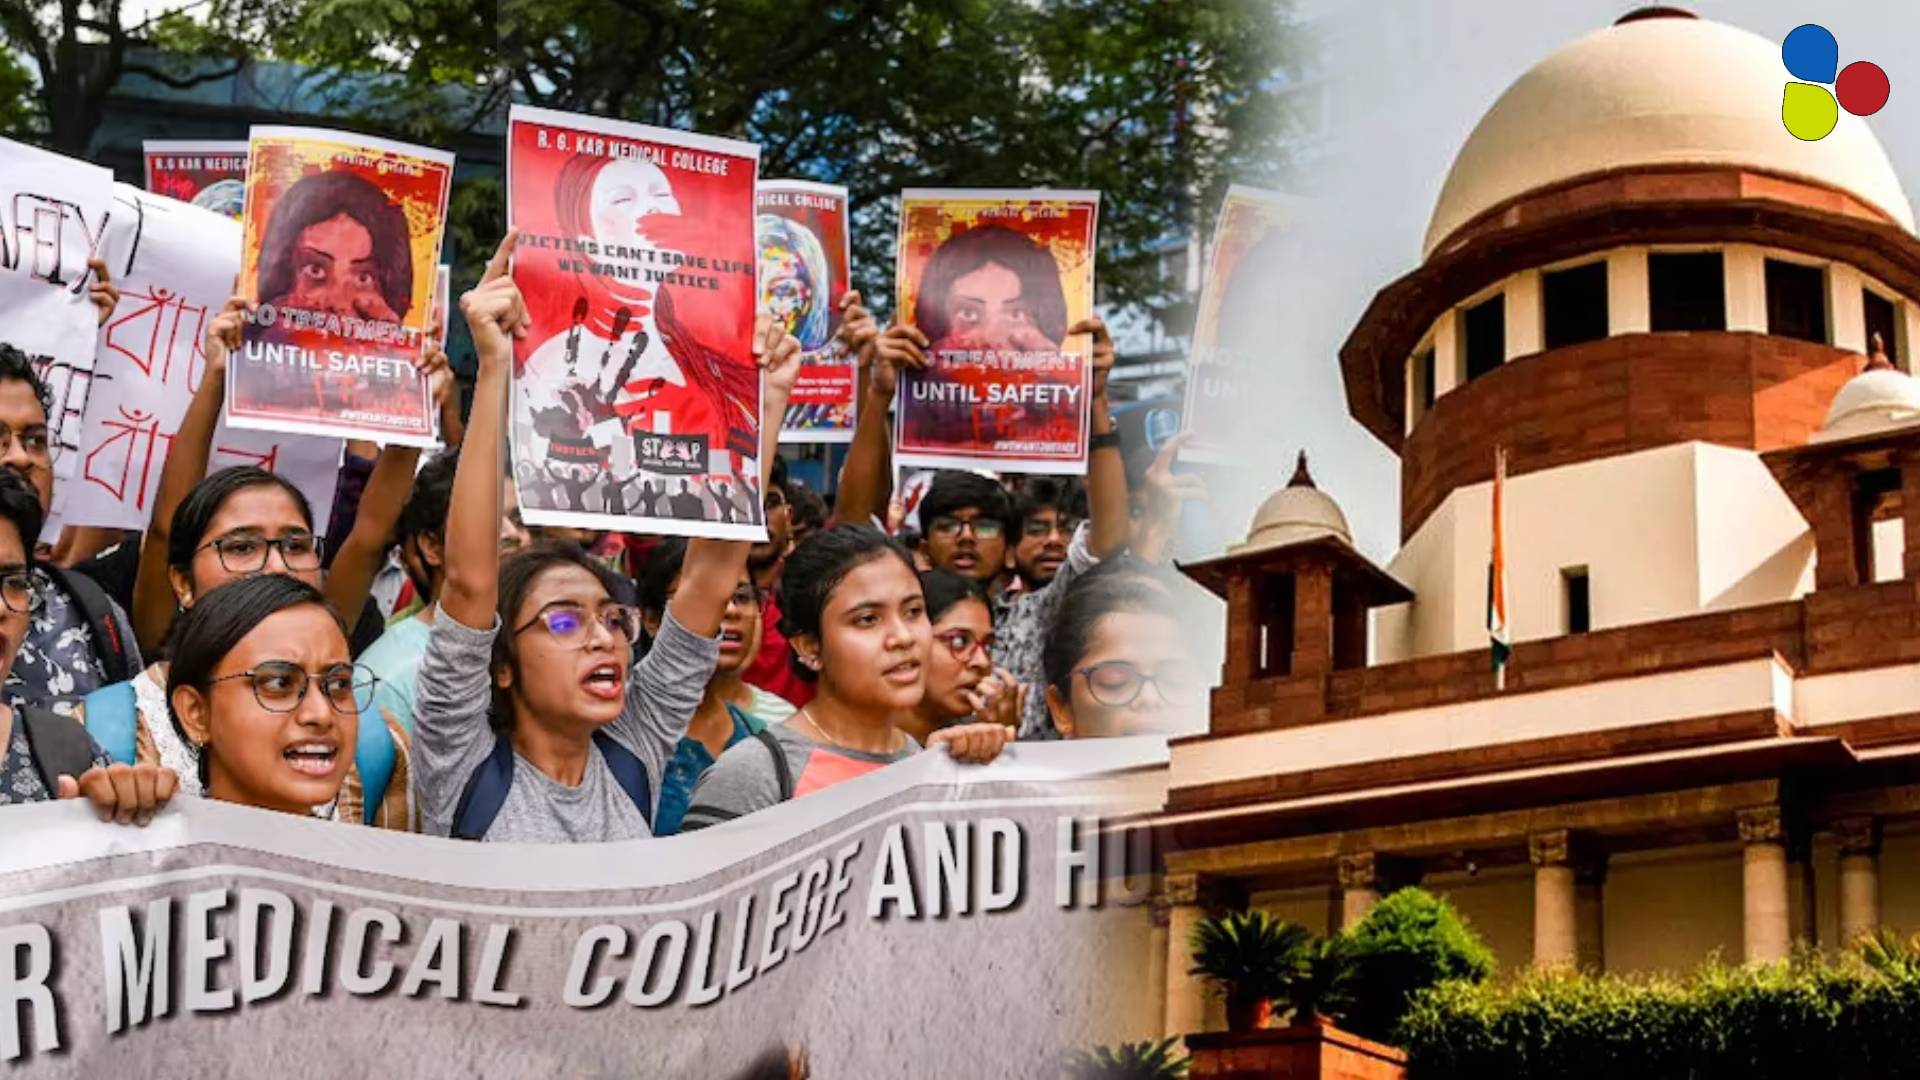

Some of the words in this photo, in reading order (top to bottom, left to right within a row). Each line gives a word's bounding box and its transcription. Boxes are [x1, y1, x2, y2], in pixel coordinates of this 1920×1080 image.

[178, 157, 201, 171] KAR
[576, 136, 604, 156] KAR
[607, 141, 668, 166] MEDICAL
[671, 151, 729, 176] COLLEGE
[518, 232, 598, 255] VICTIMS
[603, 243, 655, 264] CAN'T
[661, 251, 708, 270] SAVE
[711, 258, 754, 276] LIFE
[558, 257, 584, 273] WE
[589, 261, 639, 282] WANT
[644, 266, 720, 290] JUSTICE
[281, 306, 421, 347] TREATMENT
[246, 340, 323, 371] UNTIL
[328, 350, 418, 379] SAFETY
[939, 350, 1080, 371] TREATMENT
[912, 381, 982, 404] UNTIL
[986, 382, 1081, 405] SAFETY
[100, 887, 523, 1036] MEDICAL
[562, 840, 863, 1008] COLLEGE
[867, 816, 1022, 918] AND
